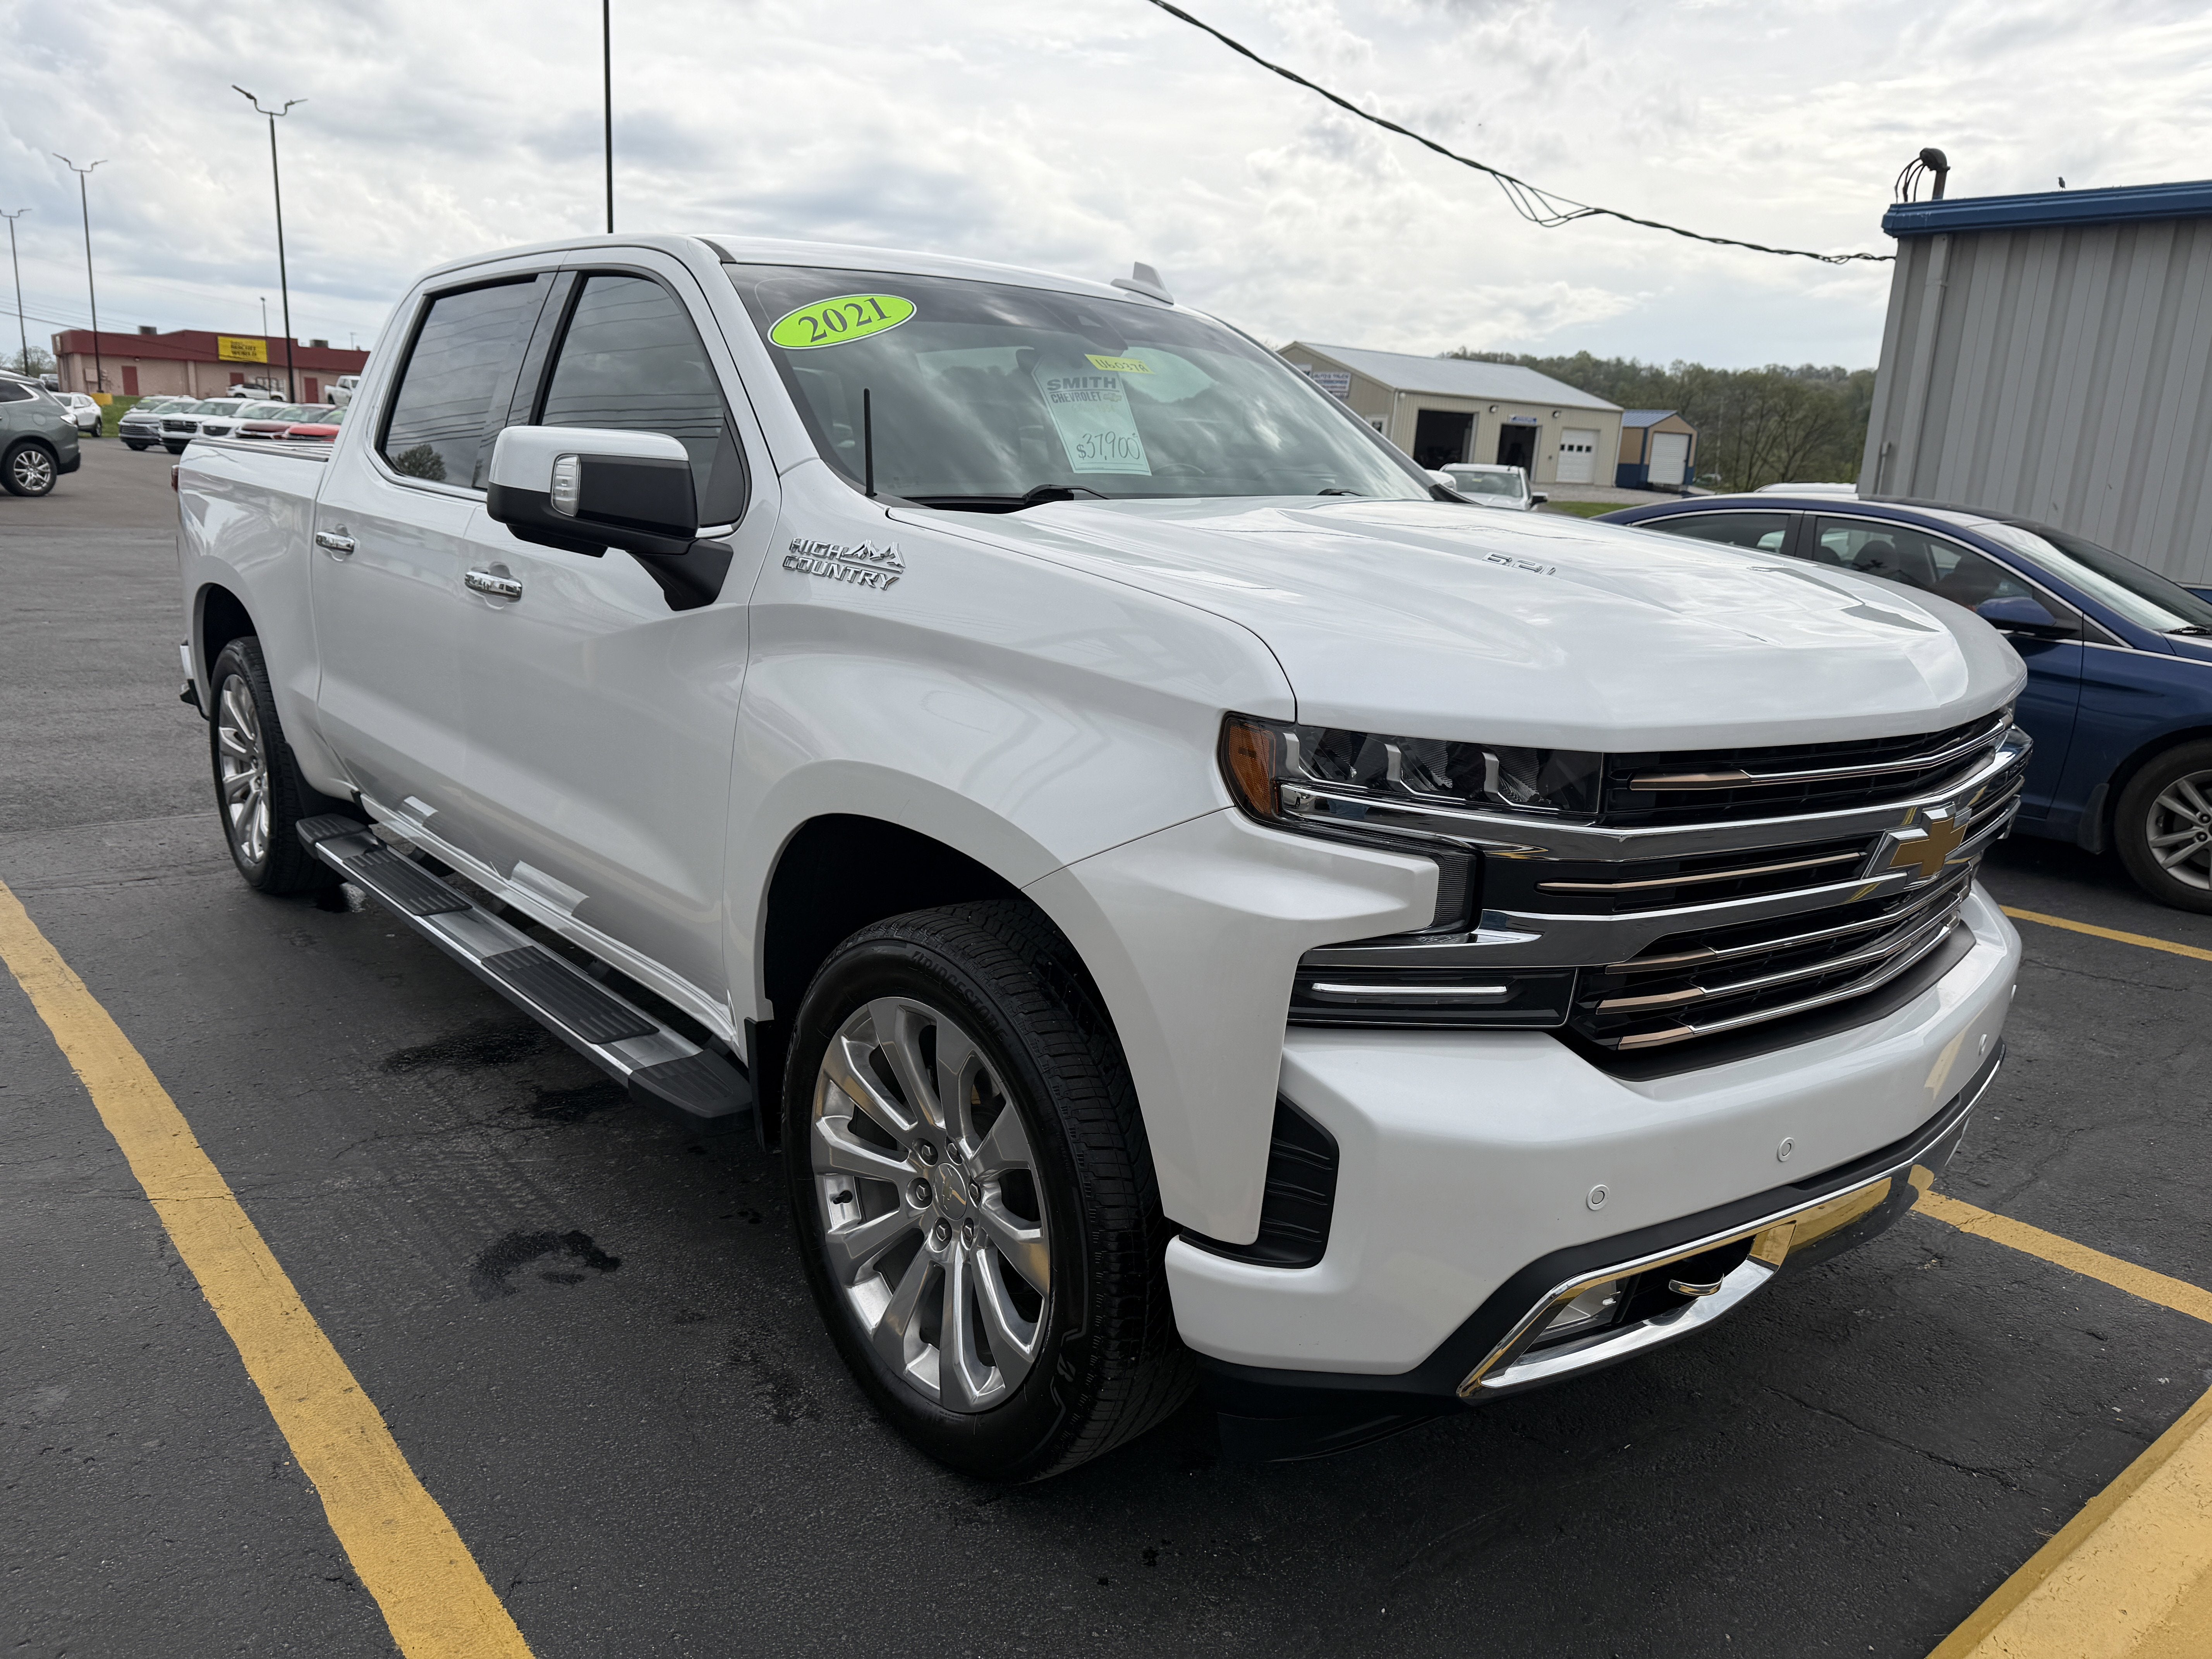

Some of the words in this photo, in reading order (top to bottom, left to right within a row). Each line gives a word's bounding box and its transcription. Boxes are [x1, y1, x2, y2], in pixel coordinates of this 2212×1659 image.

[798, 297, 892, 343] 2021
[1047, 376, 1116, 391] SMITH
[1050, 391, 1102, 404] CHEVROLET
[789, 538, 850, 560] HIGH
[782, 555, 900, 591] COUNTRY
[910, 950, 1008, 1043] BRIDGESTONE
